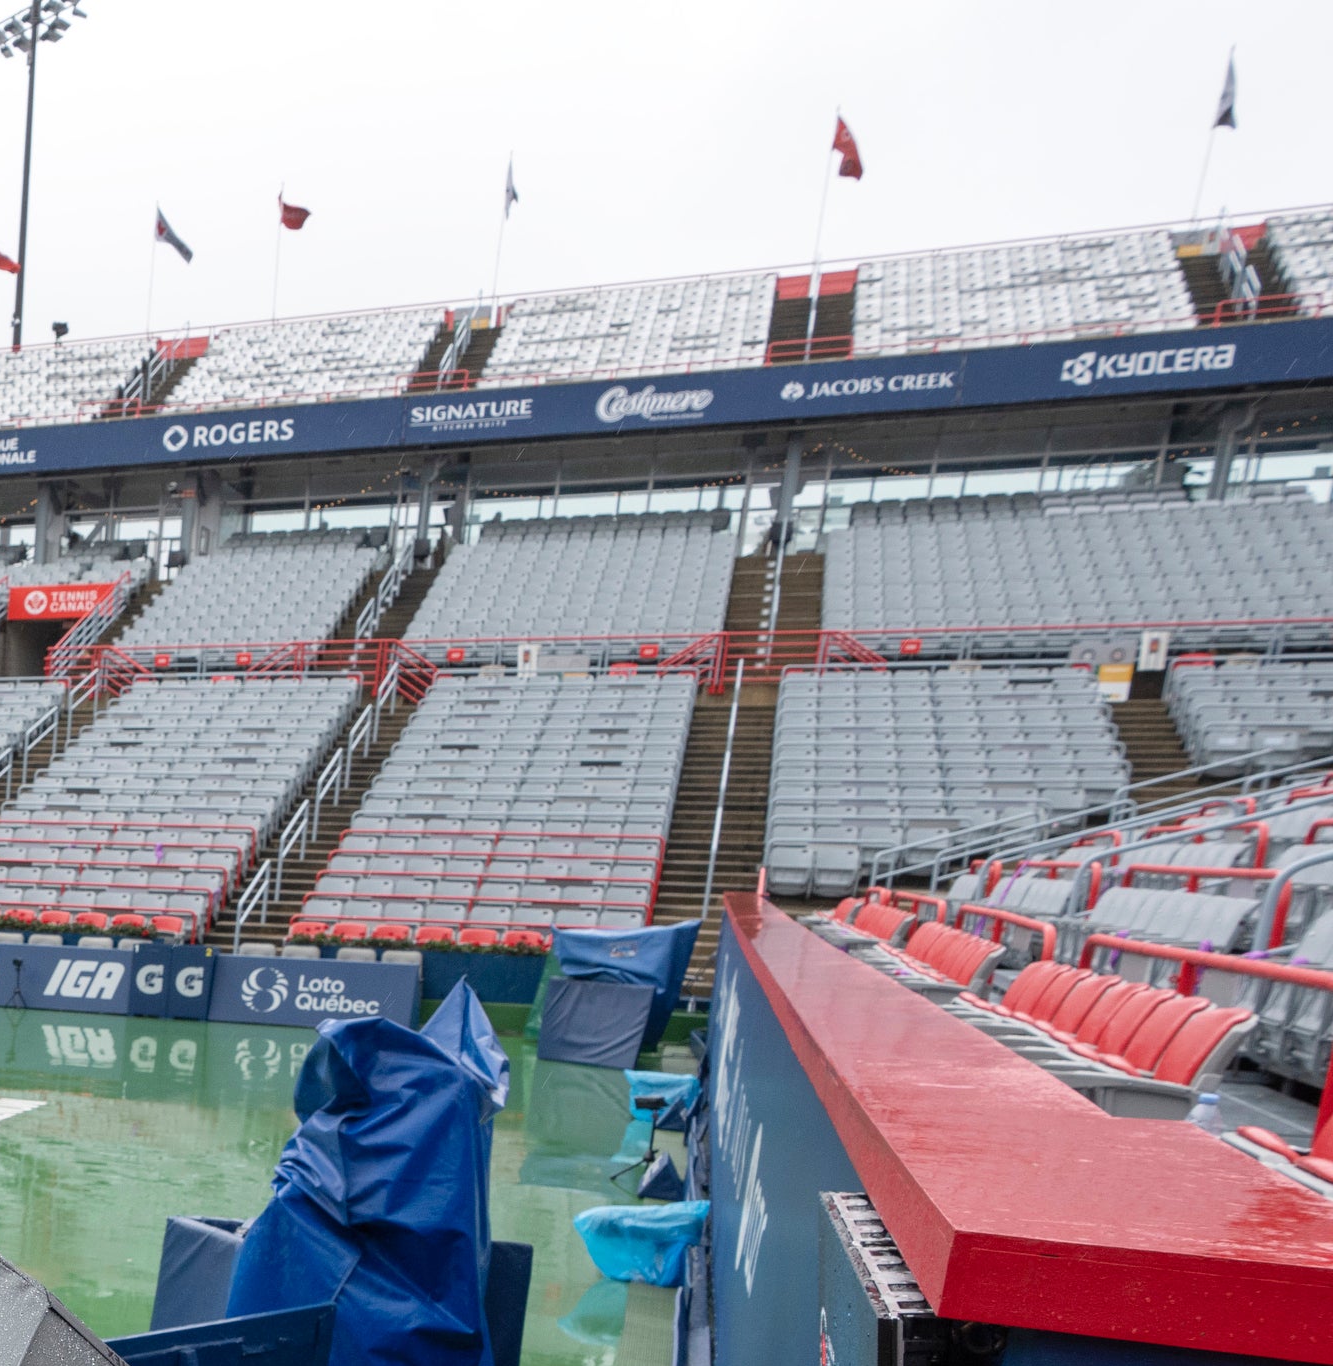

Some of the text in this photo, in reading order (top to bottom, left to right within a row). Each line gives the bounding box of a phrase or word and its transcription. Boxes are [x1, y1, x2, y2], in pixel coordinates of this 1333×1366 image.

[1095, 344, 1236, 381] KYOCERA
[806, 371, 955, 399] JACOB'S CREEK
[410, 398, 534, 423] SIGNATURE
[596, 385, 714, 423] Cashmere
[193, 418, 296, 448] ROGERS
[49, 601, 96, 613] CANAD
[50, 590, 98, 602] TENNIS
[43, 959, 126, 1000] IGA
[135, 963, 165, 995] G
[174, 966, 205, 998] G
[297, 974, 346, 994] Loto
[294, 992, 380, 1015] Québec
